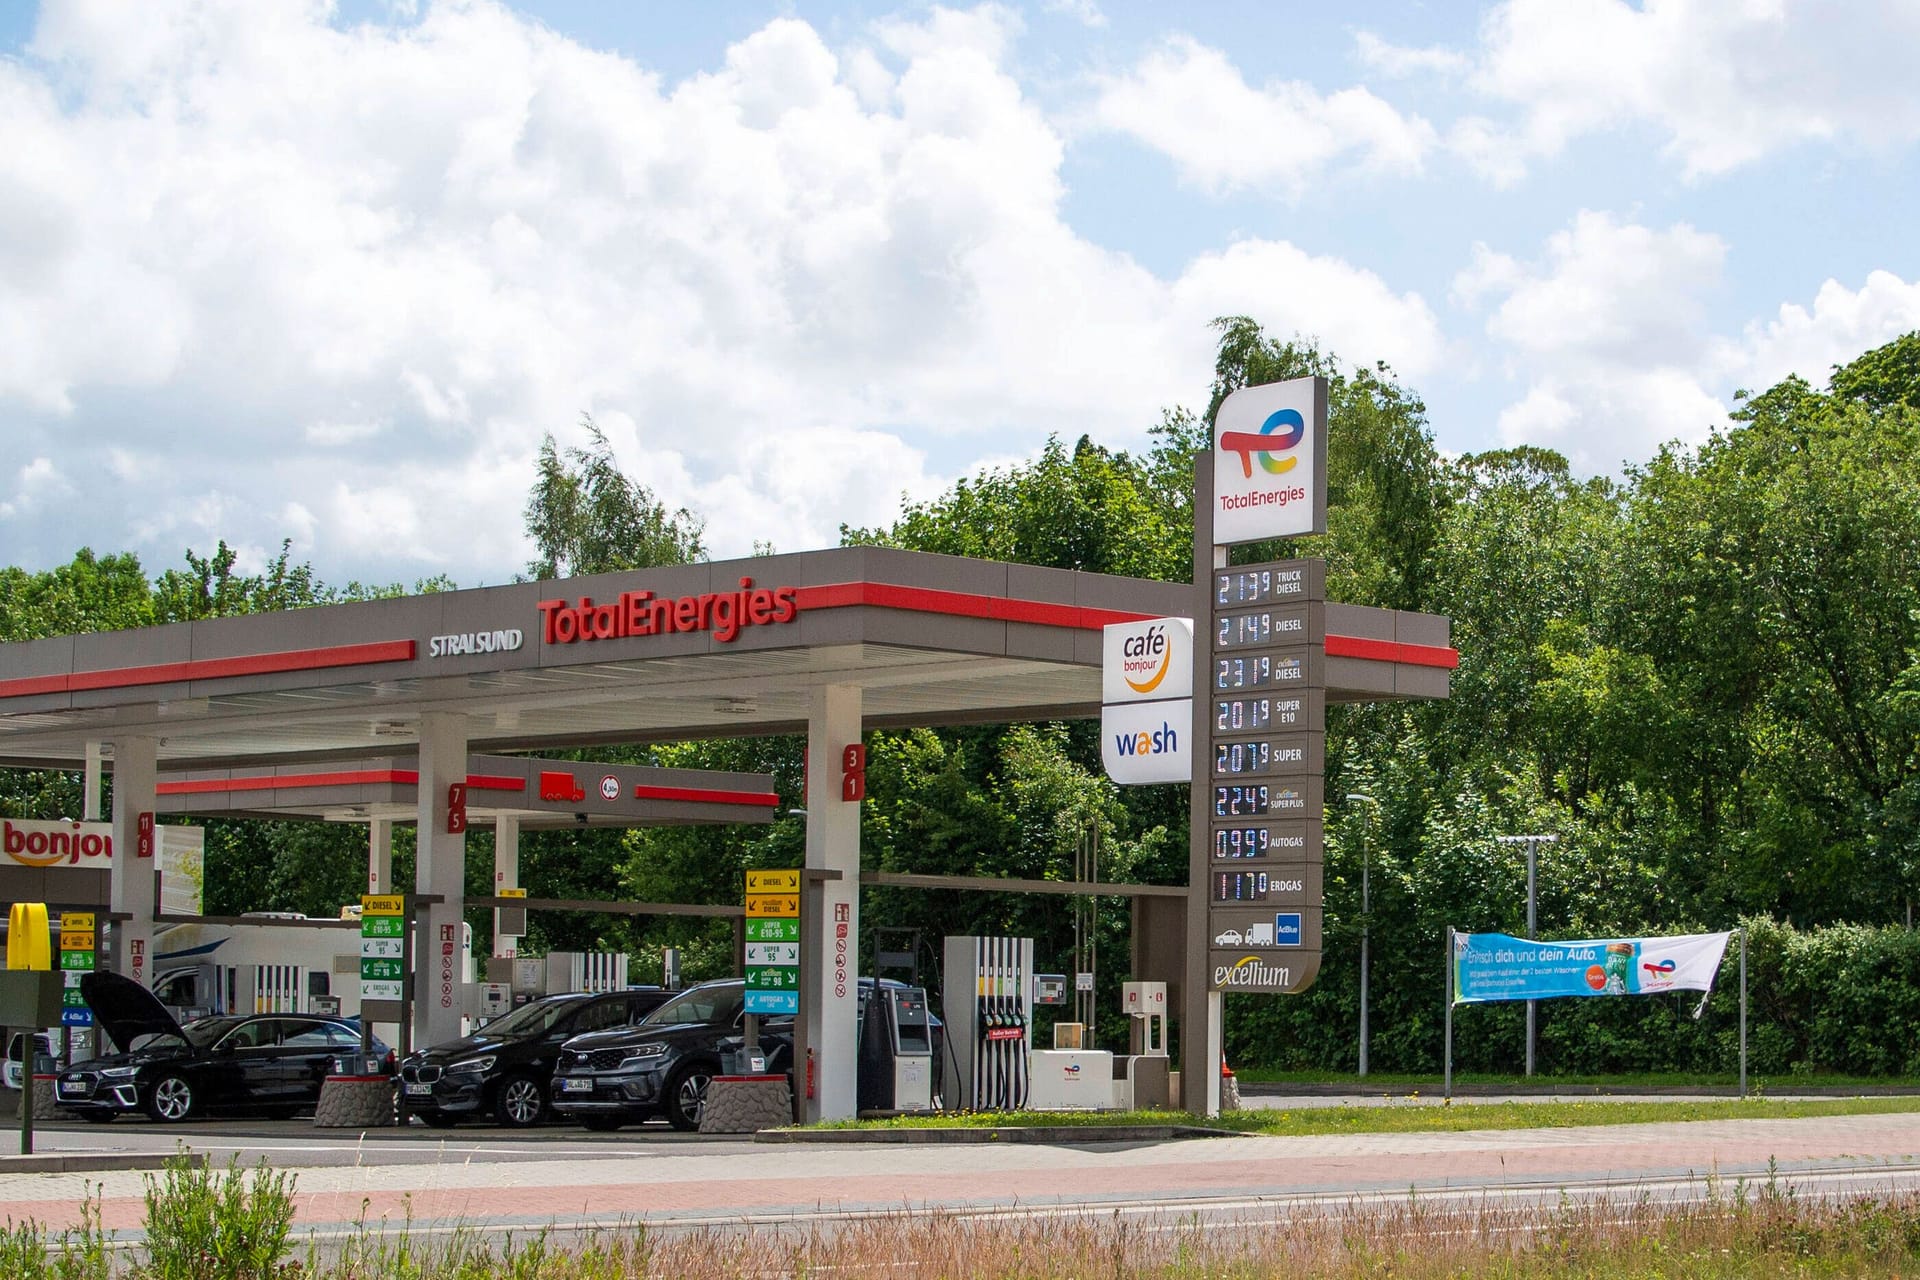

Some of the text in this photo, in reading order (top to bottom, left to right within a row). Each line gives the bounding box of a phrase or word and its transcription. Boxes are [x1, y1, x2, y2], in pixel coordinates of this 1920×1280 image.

[1220, 485, 1305, 511] TotalEnergies
[1277, 570, 1301, 582] TRUCK
[1276, 582, 1302, 595] DIESEL
[537, 576, 797, 645] TotalEnergies
[1275, 619, 1302, 632] DIESEL
[429, 629, 524, 658] STRALSUND
[1123, 625, 1165, 658] café
[1123, 659, 1158, 673] bonjour
[1275, 668, 1302, 680] DIESEL
[1276, 700, 1300, 712] SUPER
[1281, 712, 1295, 723] E10
[1116, 721, 1177, 757] wash
[849, 750, 857, 767] 3
[1273, 749, 1302, 762] SUPER
[849, 778, 856, 796] 1
[453, 788, 460, 803] 7
[1270, 799, 1304, 809] SUPER PLUS
[141, 816, 149, 830] 11
[453, 813, 460, 829] 5
[142, 839, 148, 853] 9
[1270, 837, 1303, 848] AUTOGAS
[1270, 880, 1302, 891] ERDGAS
[372, 901, 393, 910] DIESEL
[760, 928, 784, 938] E10-95
[767, 953, 777, 962] 95
[1495, 948, 1514, 963] dich
[1516, 947, 1536, 961] und
[1538, 947, 1563, 961] dein
[1566, 947, 1598, 961] Auto.
[1214, 960, 1289, 987] excellium
[773, 976, 782, 986] 98
